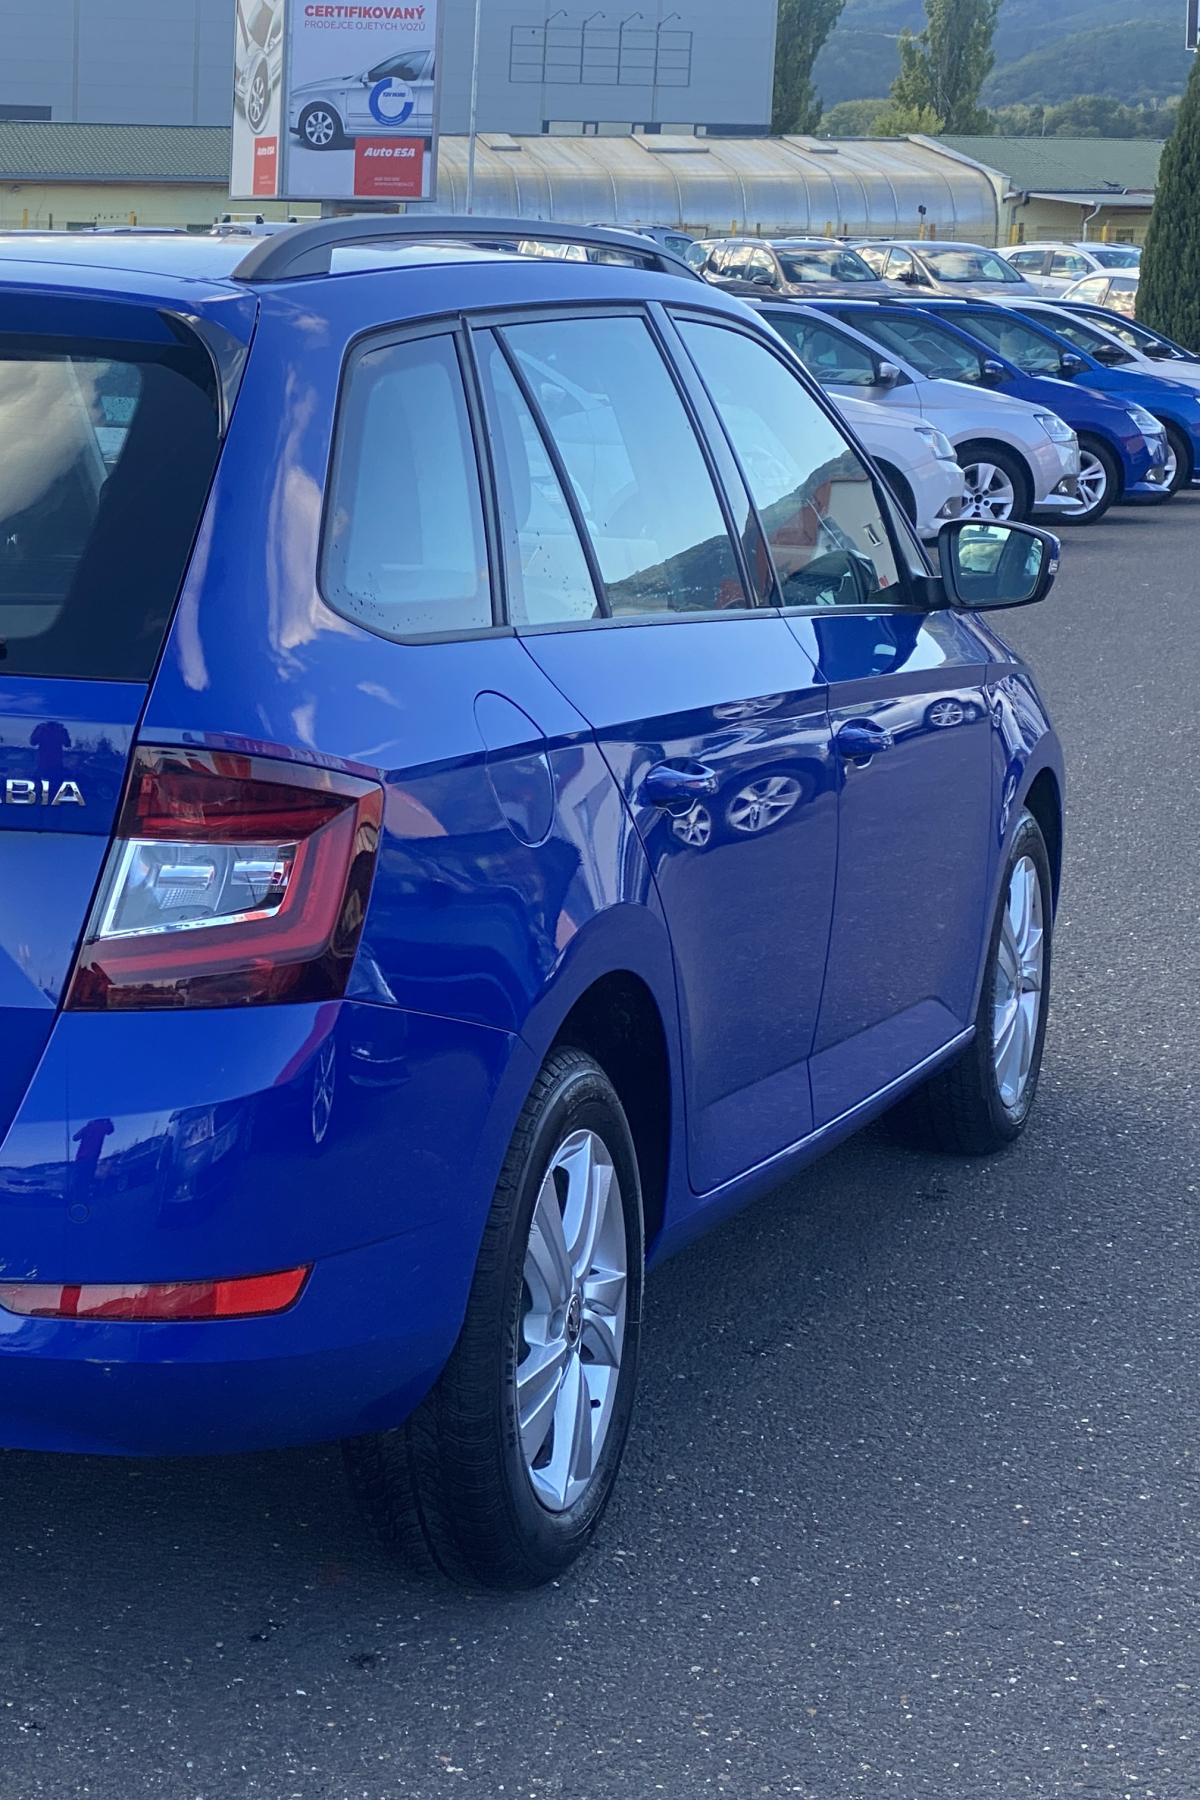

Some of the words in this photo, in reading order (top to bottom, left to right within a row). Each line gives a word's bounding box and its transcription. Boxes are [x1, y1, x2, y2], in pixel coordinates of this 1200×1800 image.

[304, 5, 425, 20] CERTIFIKOVANÝ
[304, 20, 353, 30] PRODEJCE
[364, 147, 393, 157] Auto
[393, 148, 416, 158] ESA
